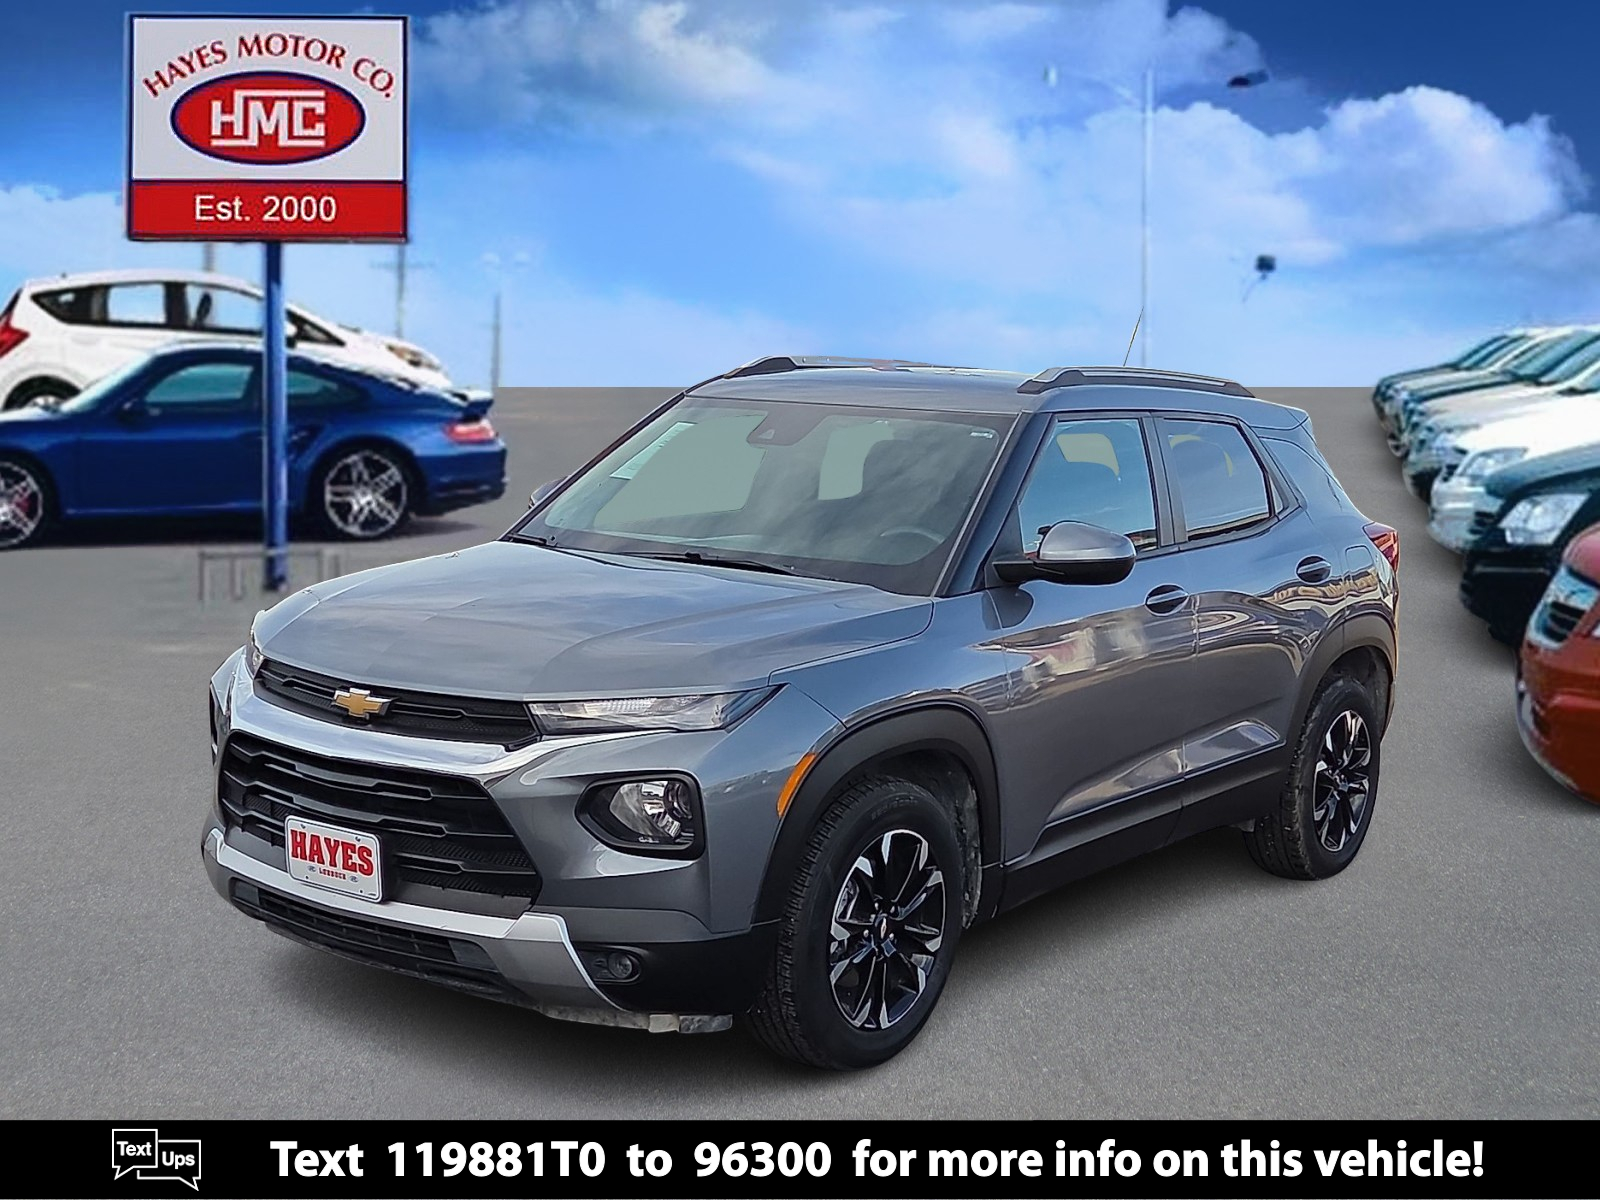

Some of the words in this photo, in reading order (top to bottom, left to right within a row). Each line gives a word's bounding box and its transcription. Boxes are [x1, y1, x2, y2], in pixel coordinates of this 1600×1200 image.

[142, 40, 228, 97] HAYES
[237, 32, 346, 69] MOTOR
[352, 57, 395, 98] CO.
[210, 89, 326, 147] HMC
[194, 194, 250, 222] Est.
[262, 194, 337, 222] 2000
[290, 829, 374, 876] HAYES
